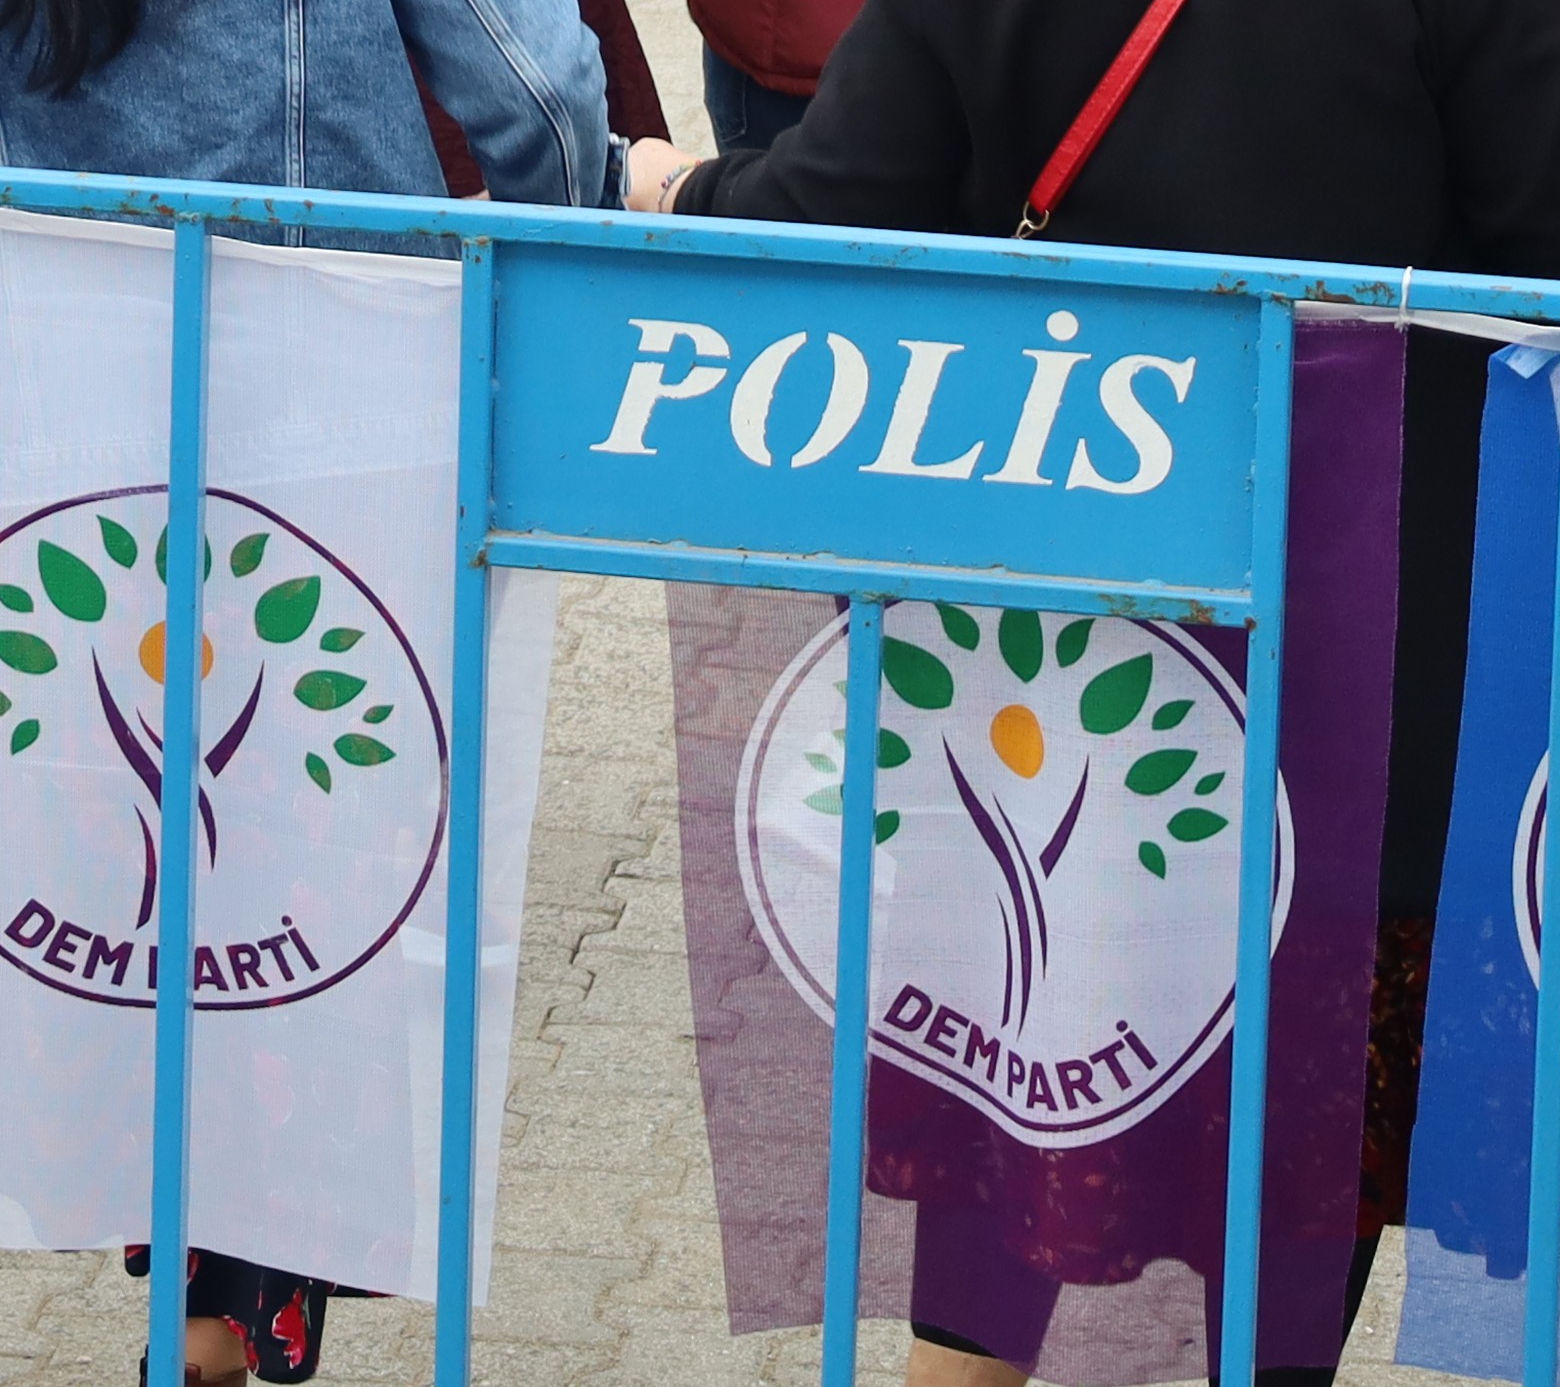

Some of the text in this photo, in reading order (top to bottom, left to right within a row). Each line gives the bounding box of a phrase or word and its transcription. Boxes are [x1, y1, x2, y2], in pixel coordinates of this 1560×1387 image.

[589, 310, 1197, 495] POLİS
[4, 898, 135, 987] DEM
[883, 983, 1158, 1112] DEM PARTİ
